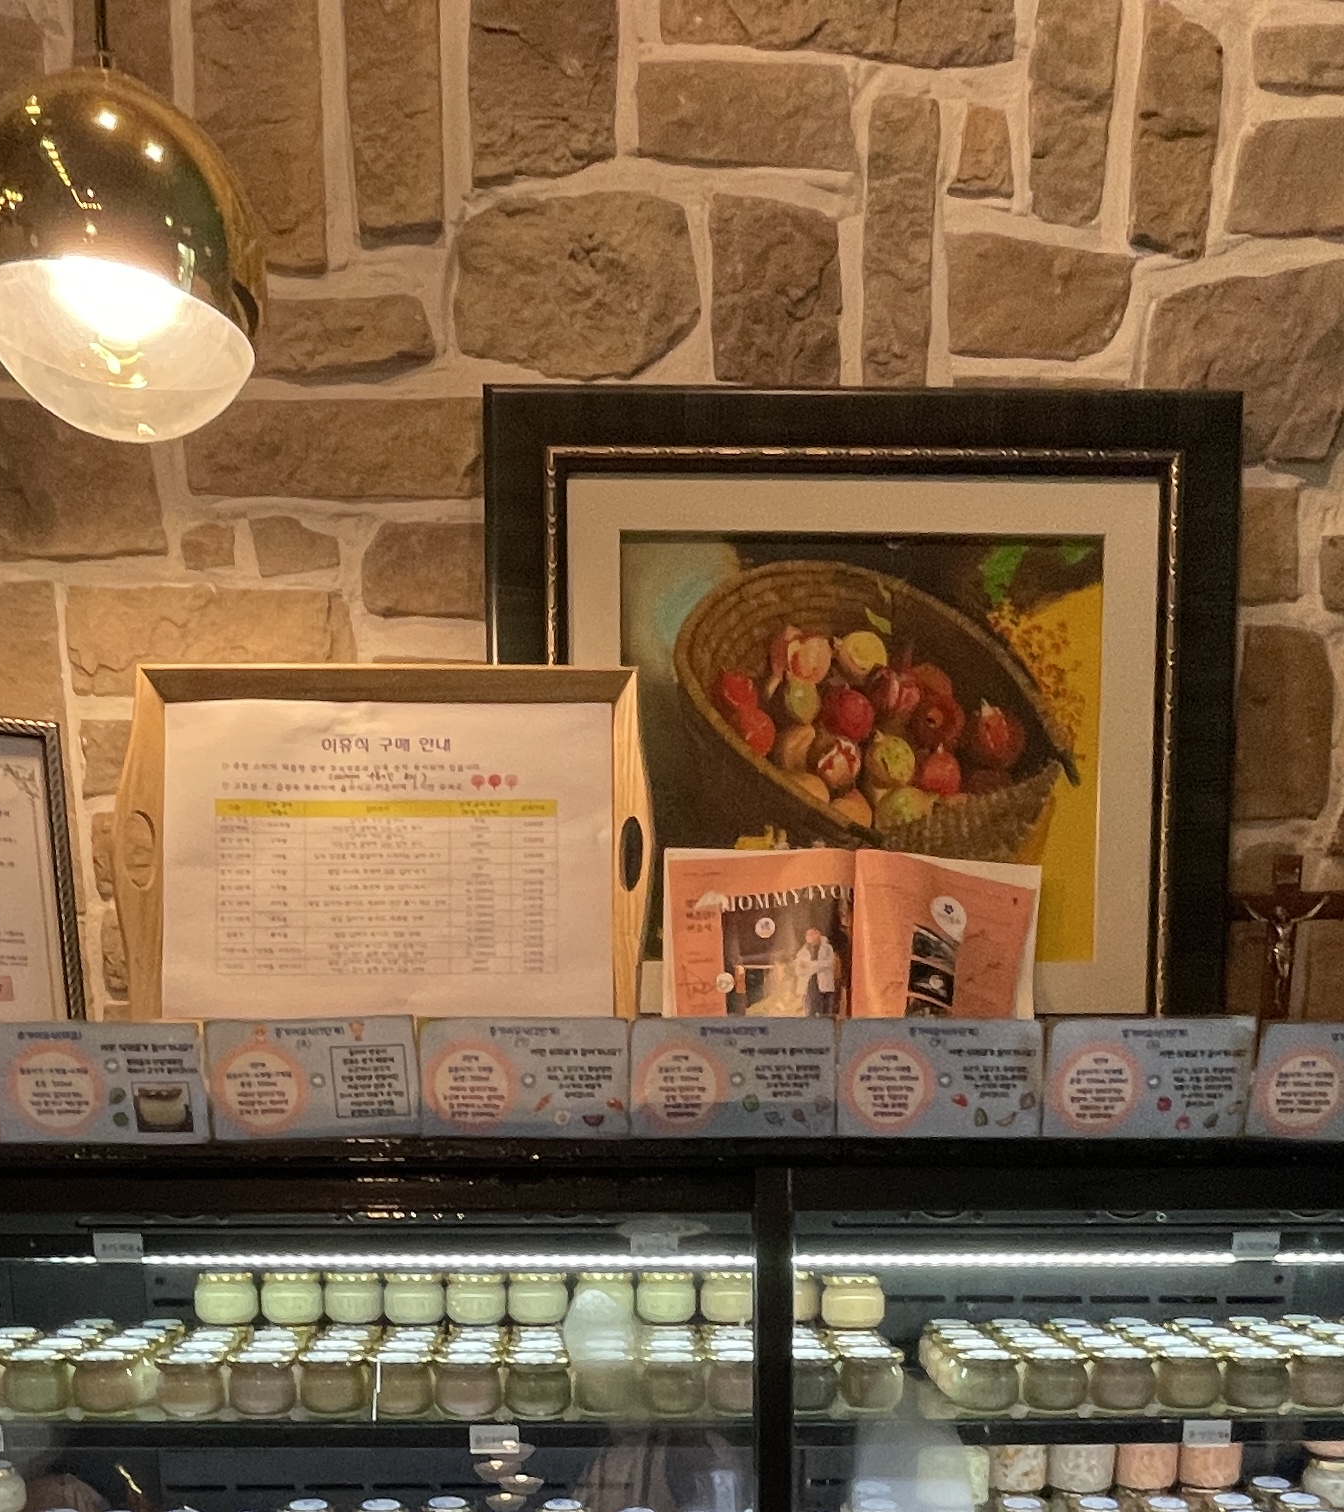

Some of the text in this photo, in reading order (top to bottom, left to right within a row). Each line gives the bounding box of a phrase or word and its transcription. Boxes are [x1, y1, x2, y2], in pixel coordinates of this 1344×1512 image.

[321, 737, 451, 754] 이유식 구매 안내
